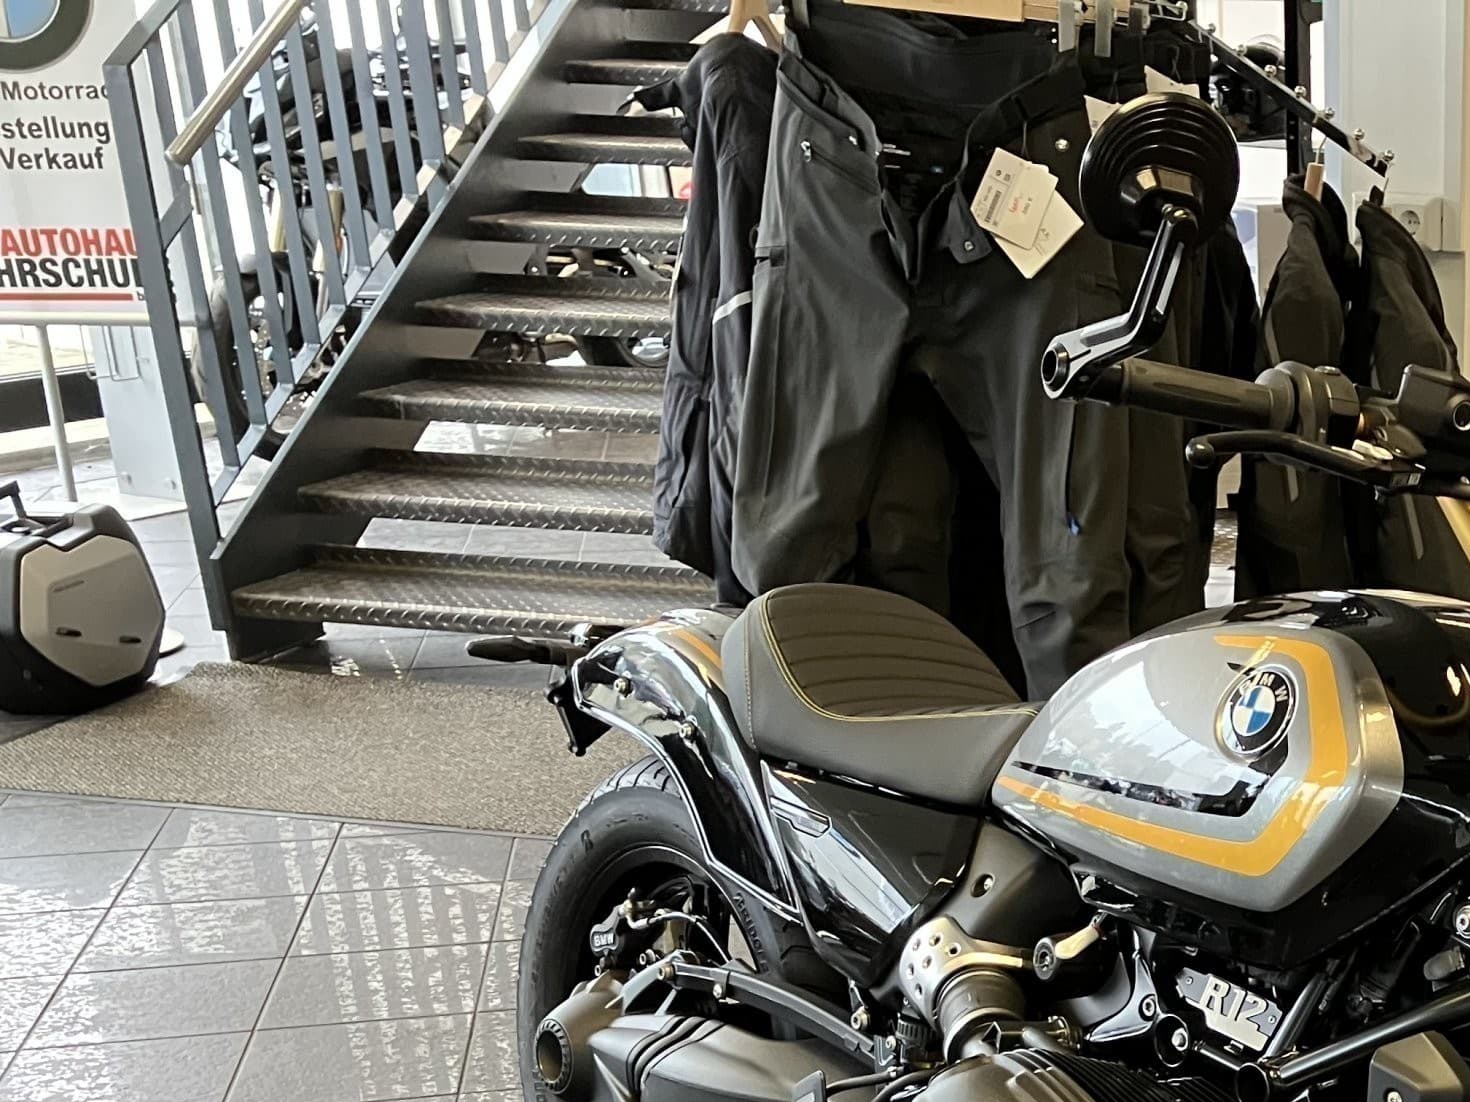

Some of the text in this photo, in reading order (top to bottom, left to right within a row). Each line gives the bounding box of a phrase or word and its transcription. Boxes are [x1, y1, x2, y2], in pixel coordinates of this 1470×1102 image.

[1, 116, 111, 144] stellung
[0, 147, 104, 170] Verkauf
[1240, 672, 1289, 702] BMW
[593, 933, 614, 947] BMW
[1201, 974, 1269, 1031] R12
